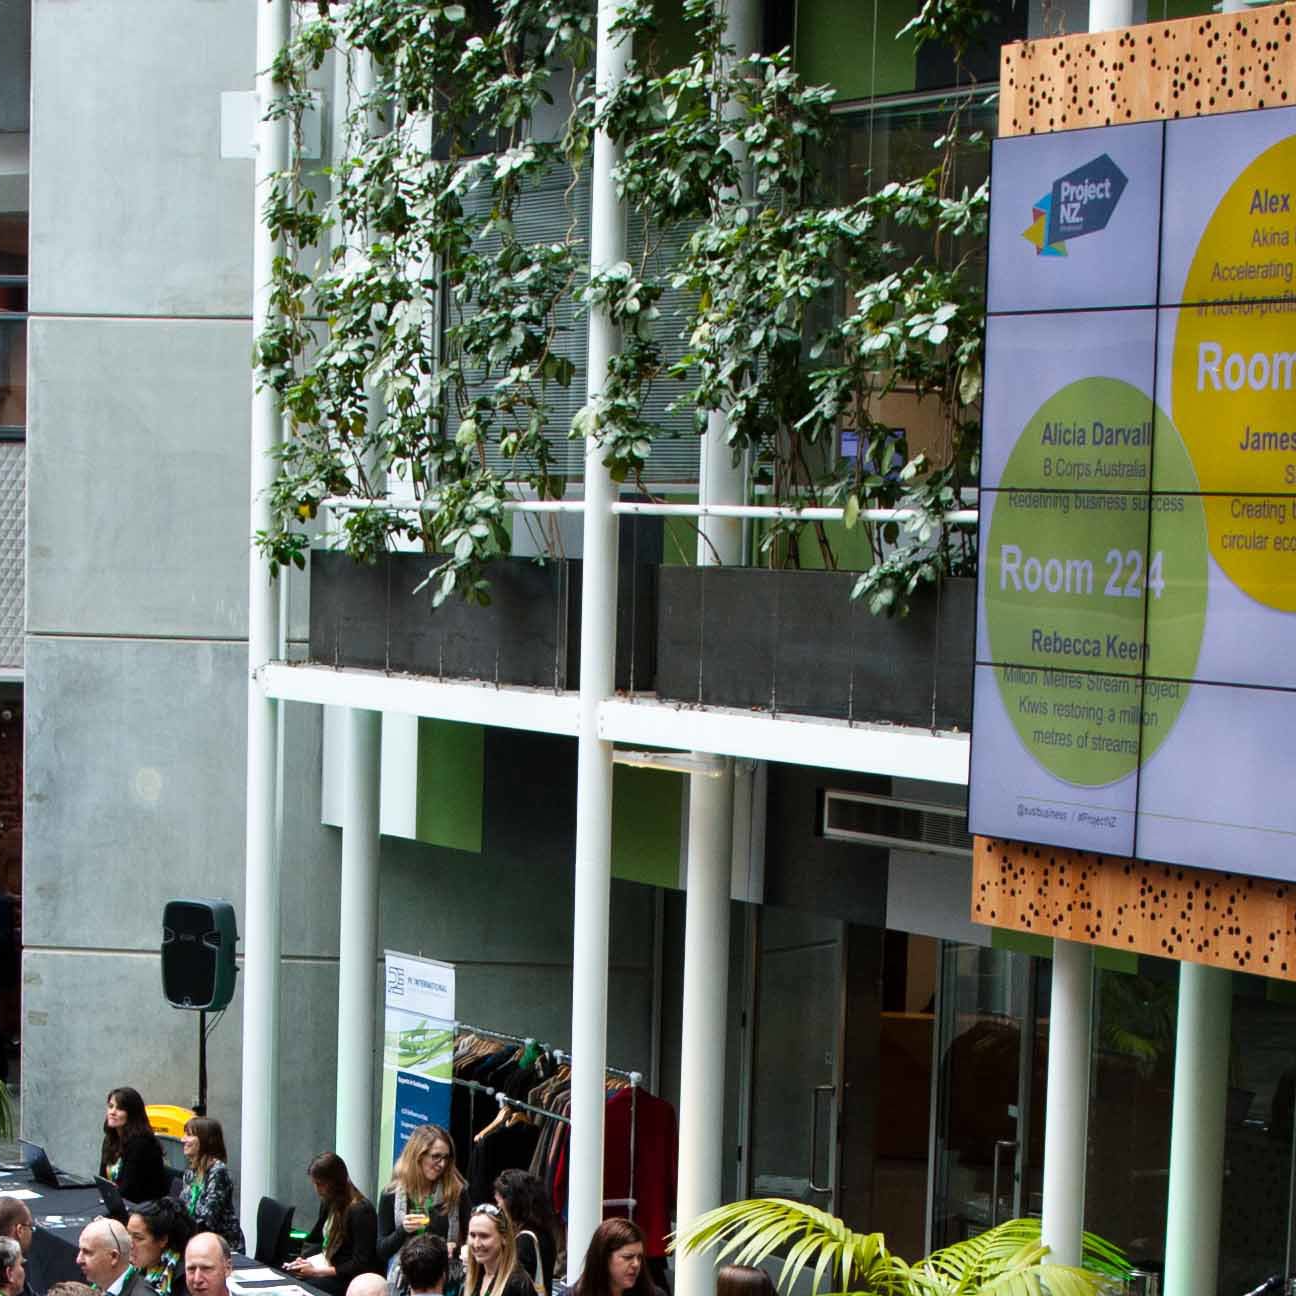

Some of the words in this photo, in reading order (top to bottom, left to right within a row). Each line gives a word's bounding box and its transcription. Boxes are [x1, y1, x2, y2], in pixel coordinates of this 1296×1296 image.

[1060, 178, 1111, 204] Project
[1249, 188, 1290, 215] Alex
[1251, 228, 1289, 248] Akina
[1211, 260, 1293, 283] Accelerating
[1041, 422, 1086, 447] Alicia
[1092, 421, 1152, 447] Darvall
[1043, 457, 1052, 478] B
[1056, 458, 1091, 481] Corps
[1094, 459, 1147, 479] Australia
[1231, 498, 1286, 525] Creating
[1221, 530, 1270, 550] circular
[999, 543, 1094, 594] Room
[1104, 548, 1165, 600] 224
[1031, 628, 1102, 657] Rebecca
[1019, 695, 1049, 715] Kiwis
[1053, 700, 1104, 726] restoring
[1107, 709, 1115, 722] a
[1033, 729, 1073, 748] metres
[1077, 729, 1088, 748] of
[1092, 733, 1138, 754] streams
